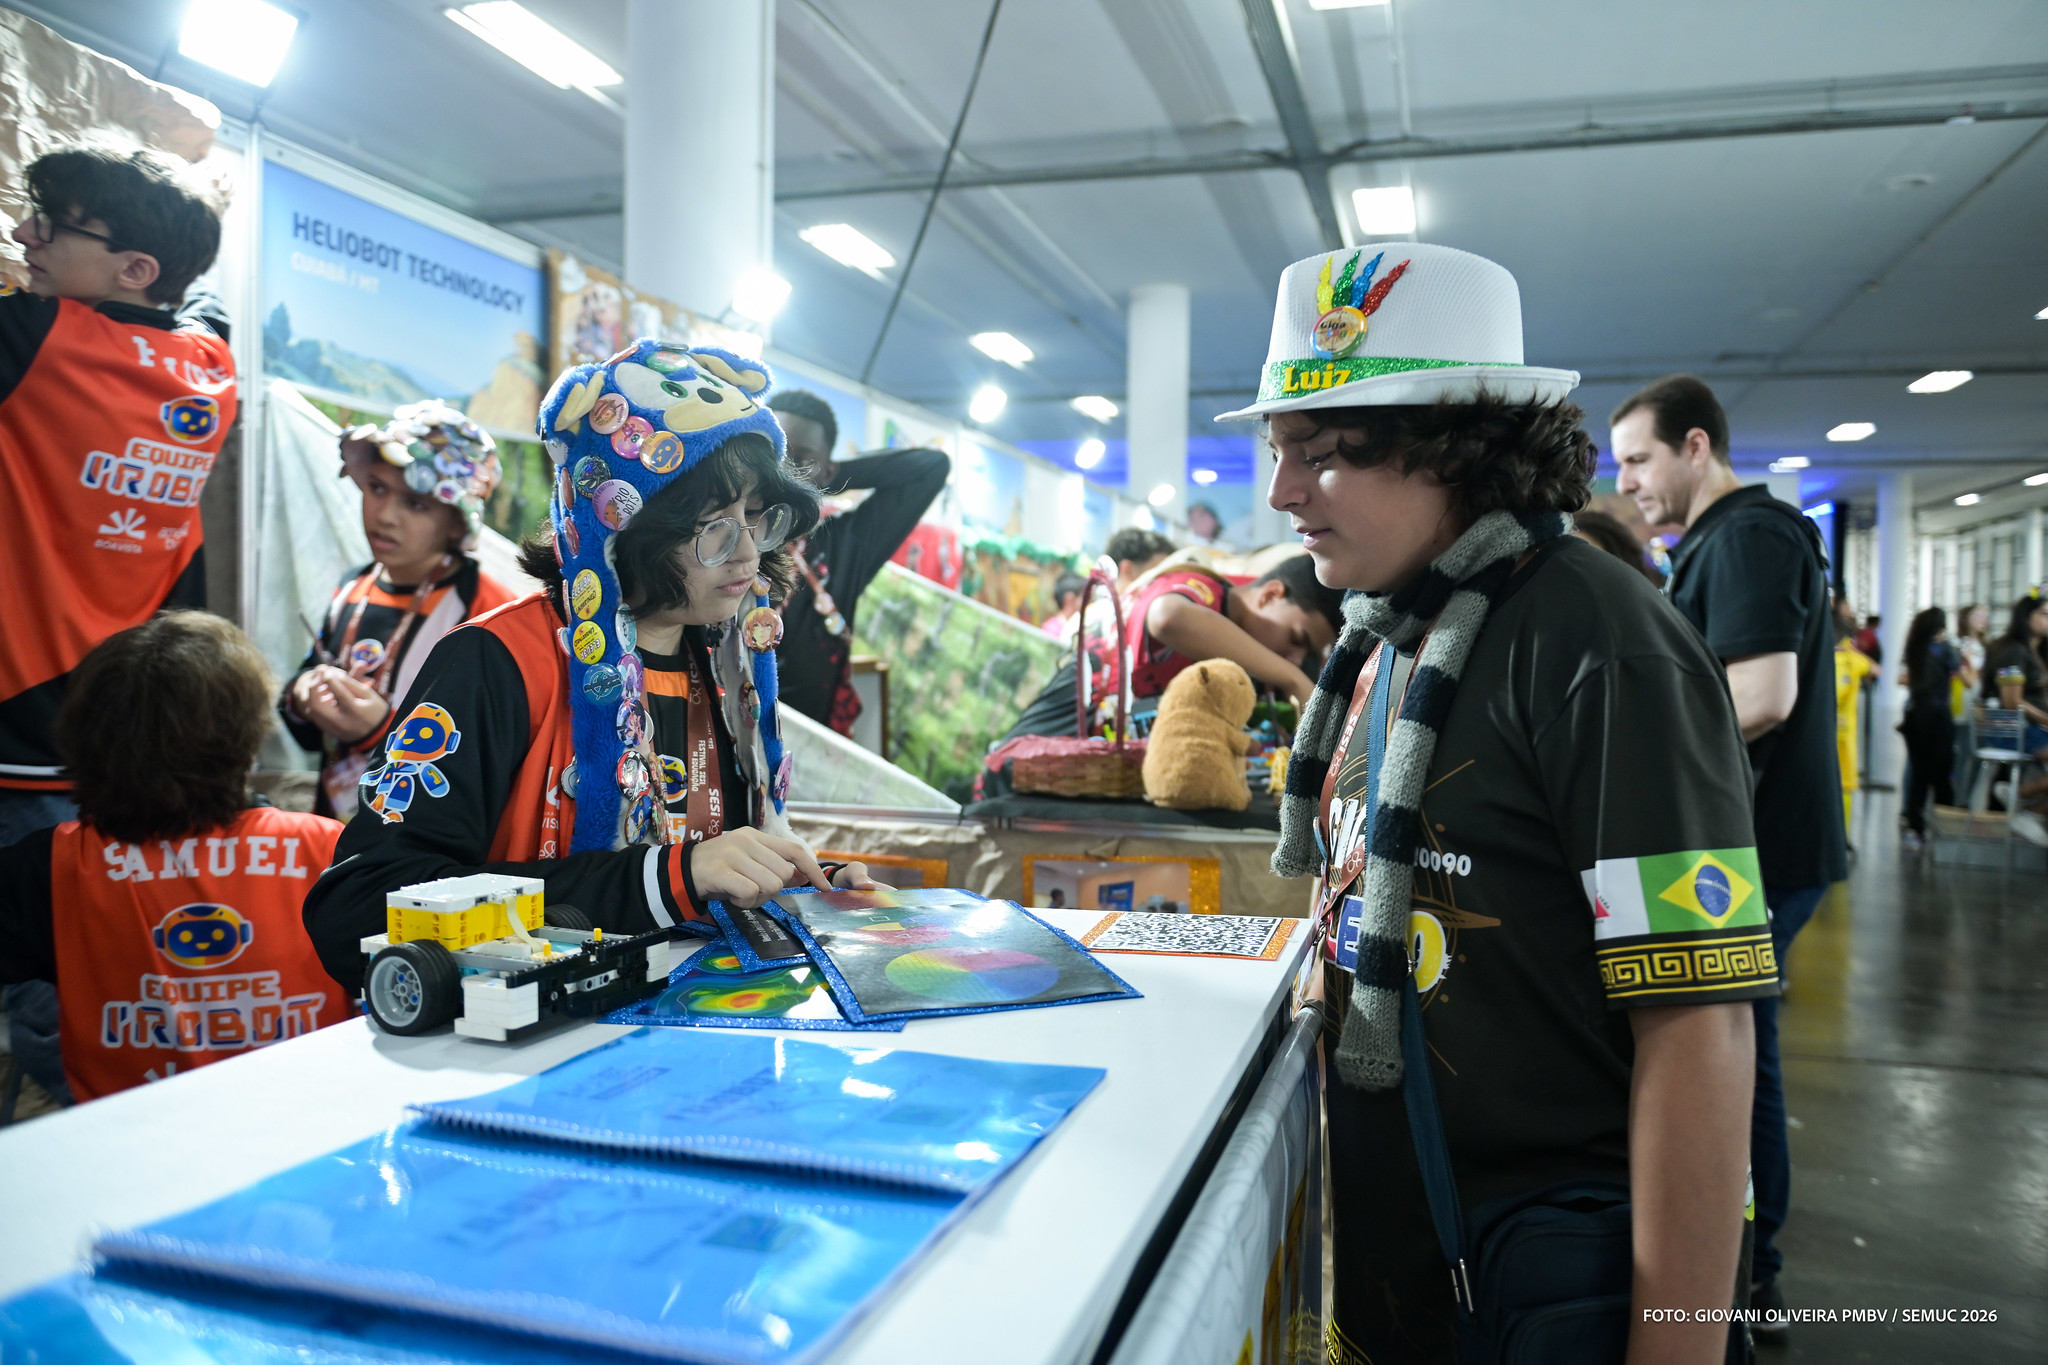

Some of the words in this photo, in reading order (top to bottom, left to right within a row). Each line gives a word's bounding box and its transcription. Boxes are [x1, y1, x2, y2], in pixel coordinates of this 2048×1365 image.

[293, 212, 403, 272] HELIOBOT
[406, 252, 525, 313] TECHNOLOGY
[1282, 363, 1352, 393] Luiz
[615, 487, 630, 505] RIO
[623, 494, 640, 516] BOTS
[698, 740, 706, 769] FESTIVAL
[104, 836, 307, 882] SAMUEL
[1414, 846, 1472, 877] 0090
[143, 972, 278, 1004] EQUIPE
